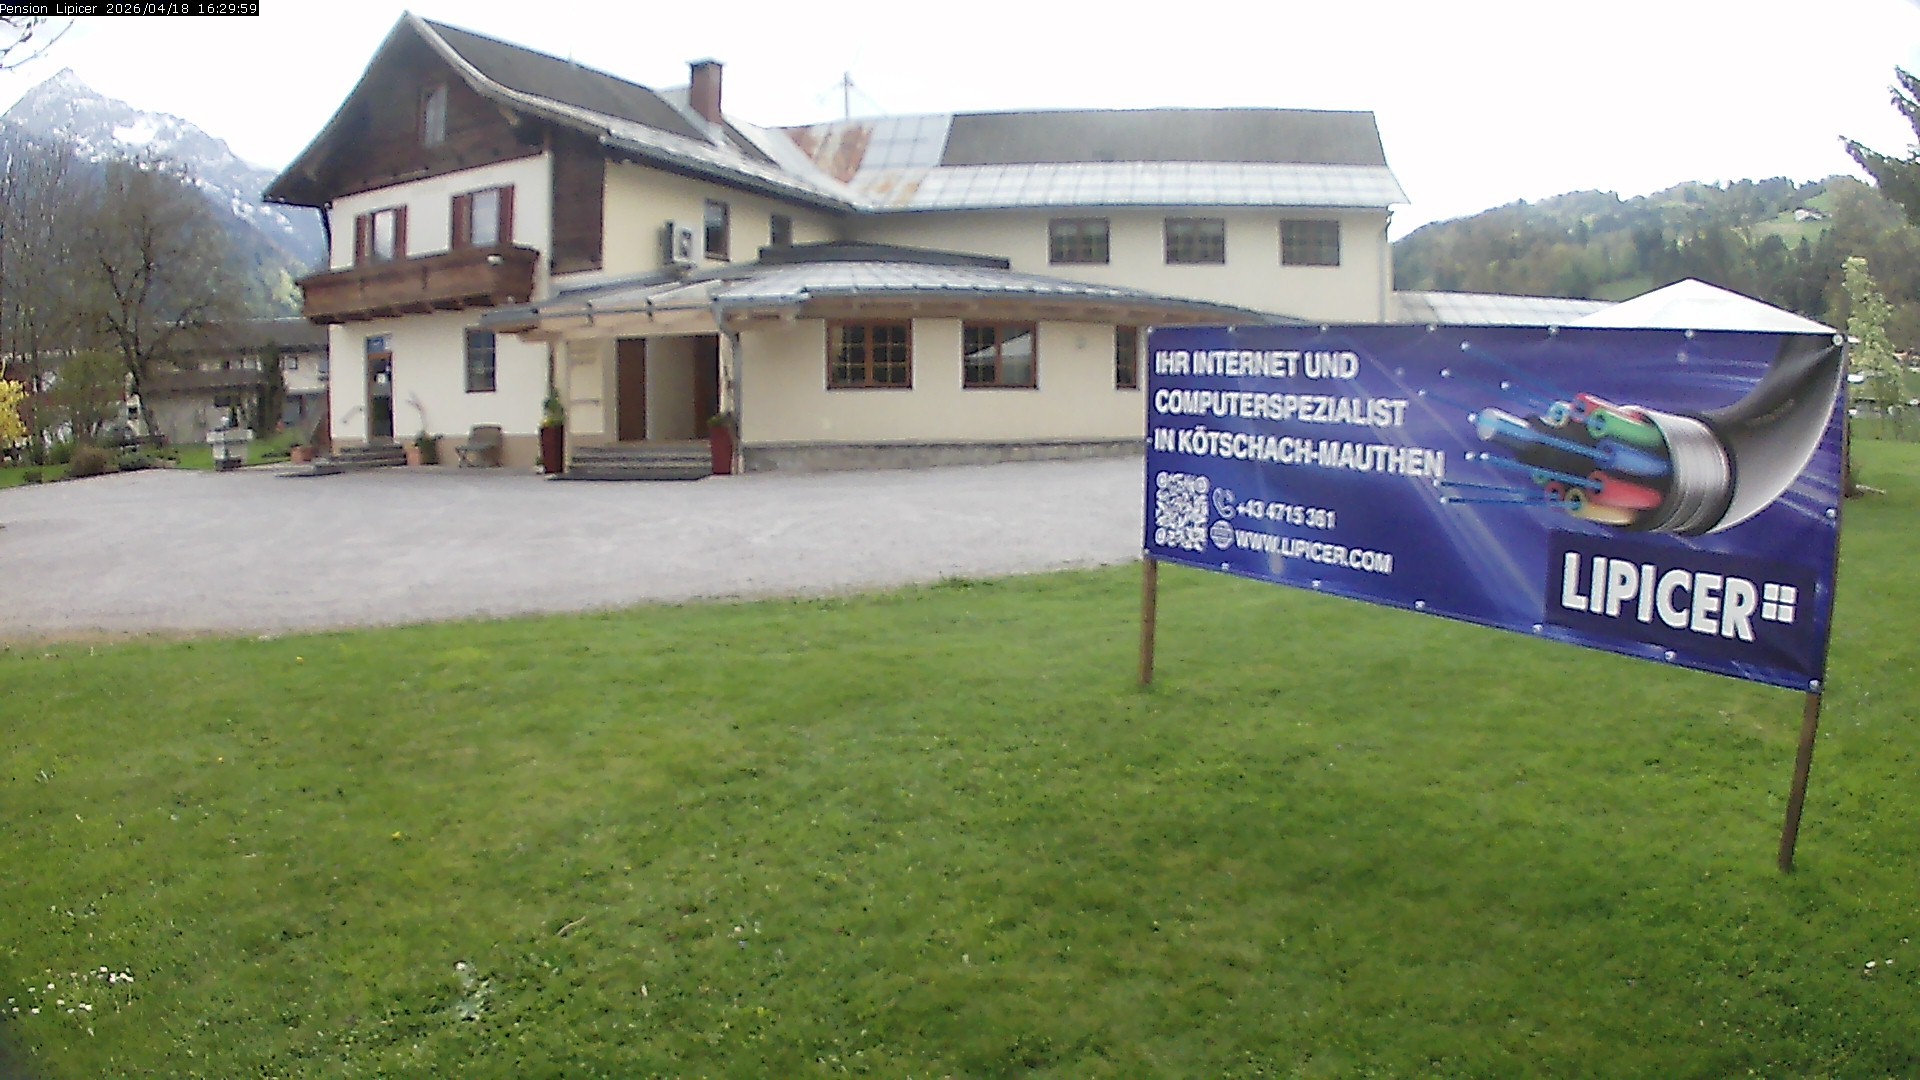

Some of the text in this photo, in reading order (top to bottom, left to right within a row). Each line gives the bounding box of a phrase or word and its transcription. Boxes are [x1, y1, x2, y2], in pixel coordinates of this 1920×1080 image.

[1155, 351, 1360, 379] IHR INTERNET UND
[1155, 389, 1409, 427] COMPUTERSPEZIALIST
[1154, 425, 1447, 477] IN KÖTSCHACH-MAUTHEN
[1236, 499, 1265, 520] +43
[1266, 502, 1305, 526] 4715
[1235, 529, 1394, 575] WWW.LIPICER.COM
[1561, 552, 1758, 642] LIPICER
